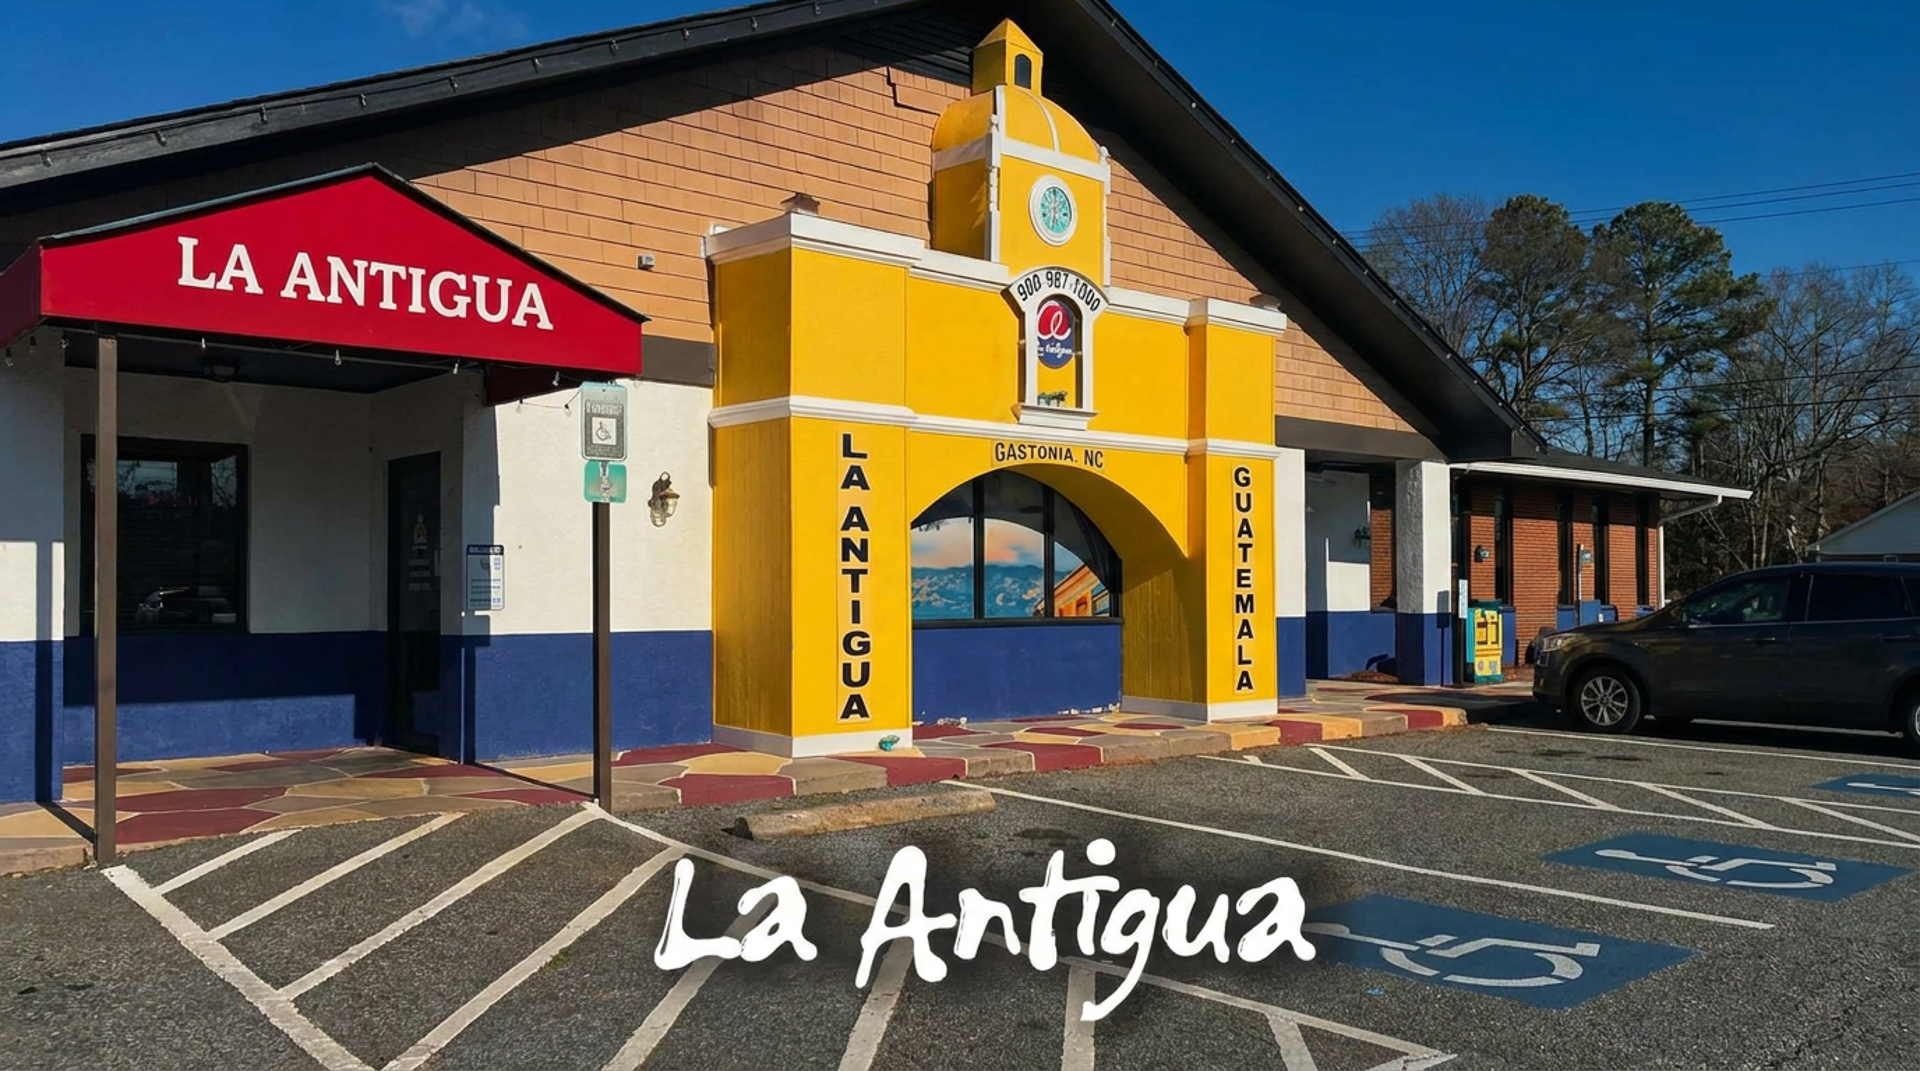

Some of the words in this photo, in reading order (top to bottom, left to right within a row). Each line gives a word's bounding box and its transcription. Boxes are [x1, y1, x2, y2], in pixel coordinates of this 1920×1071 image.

[177, 235, 264, 295] LA
[280, 251, 556, 331] ANTIGUA
[840, 433, 870, 492] LA
[1084, 449, 1104, 469] NC
[840, 505, 871, 720] ANTIGUA
[1233, 466, 1255, 692] GUATEMALA
